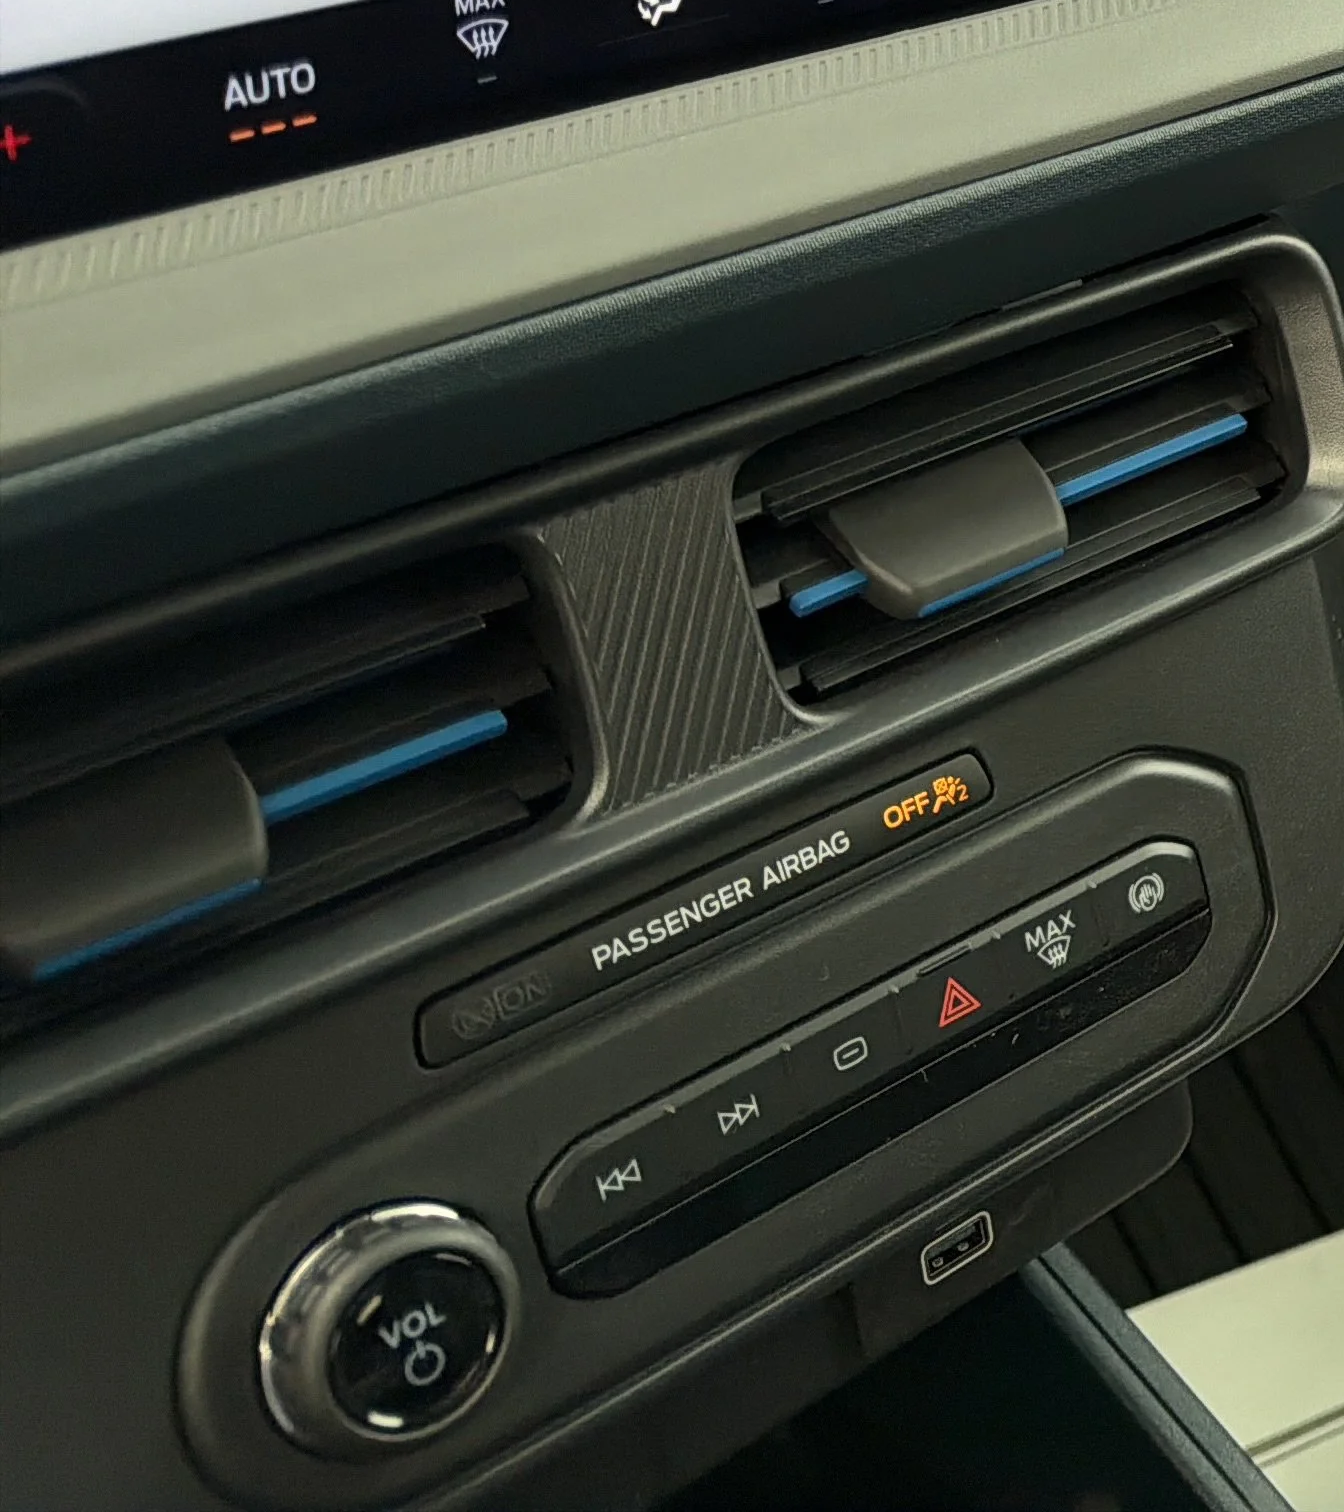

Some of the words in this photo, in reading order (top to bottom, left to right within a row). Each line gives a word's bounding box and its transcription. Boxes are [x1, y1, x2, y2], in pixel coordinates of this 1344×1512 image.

[225, 63, 315, 110] AUTO
[884, 792, 929, 827] OFF
[592, 878, 753, 970] PASSENGER
[764, 831, 849, 889] AIRBAG
[1024, 910, 1077, 952] MAX
[378, 1301, 446, 1349] VOL
